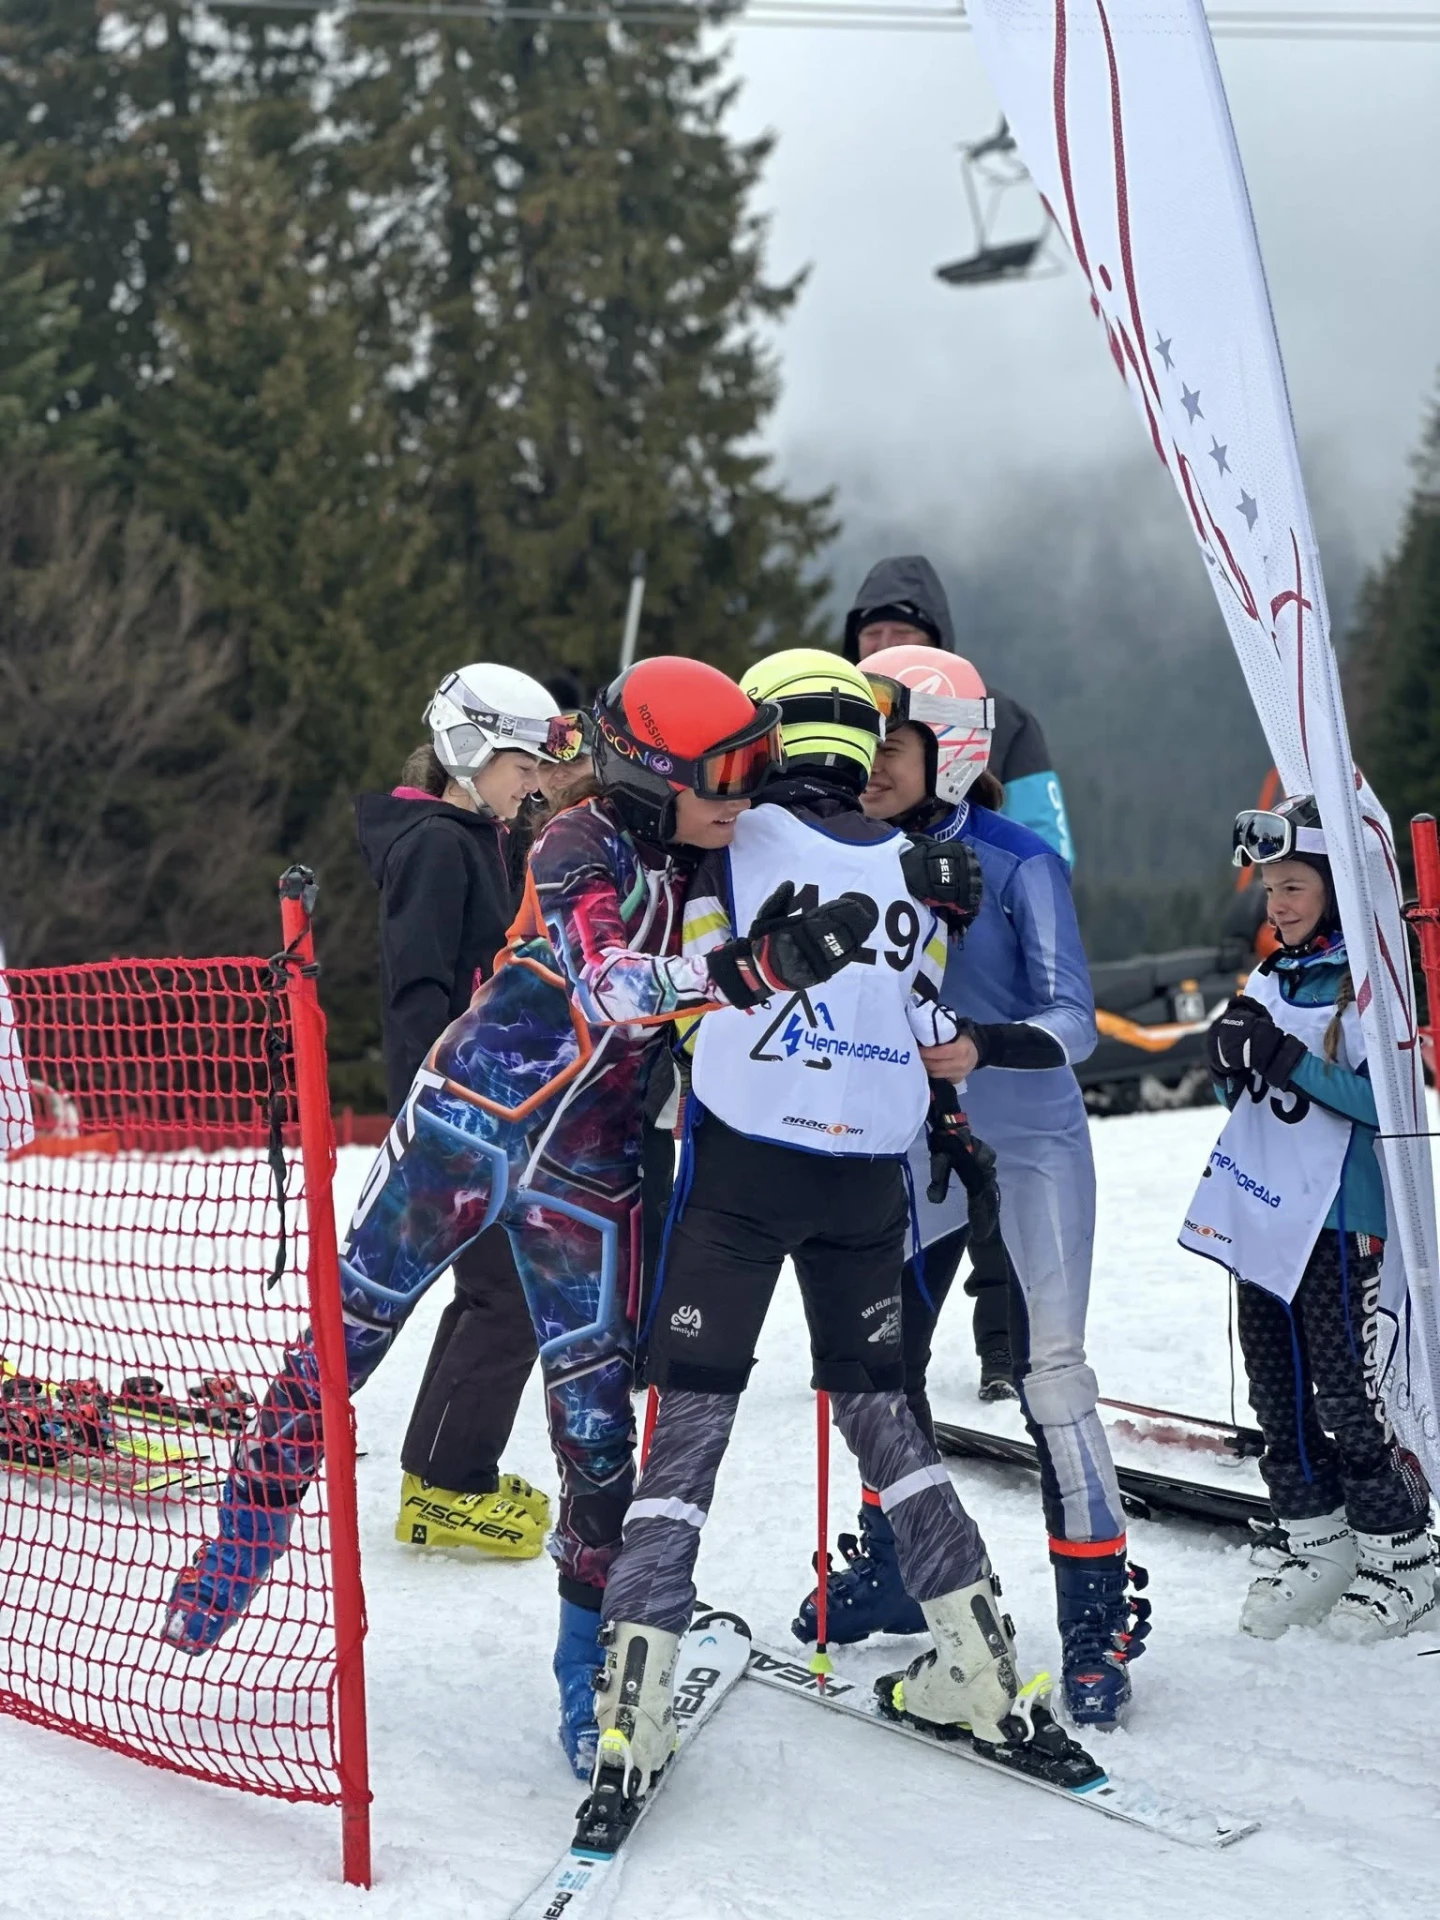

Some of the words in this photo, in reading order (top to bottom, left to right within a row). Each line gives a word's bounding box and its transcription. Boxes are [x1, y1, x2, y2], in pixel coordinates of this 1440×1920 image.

[939, 858, 950, 884] SEIZ
[823, 932, 845, 958] SEIZ
[861, 1305, 875, 1319] SKI
[405, 1495, 524, 1545] FISCHER
[1303, 1529, 1349, 1549] HEAD
[750, 1649, 856, 1698] HEA
